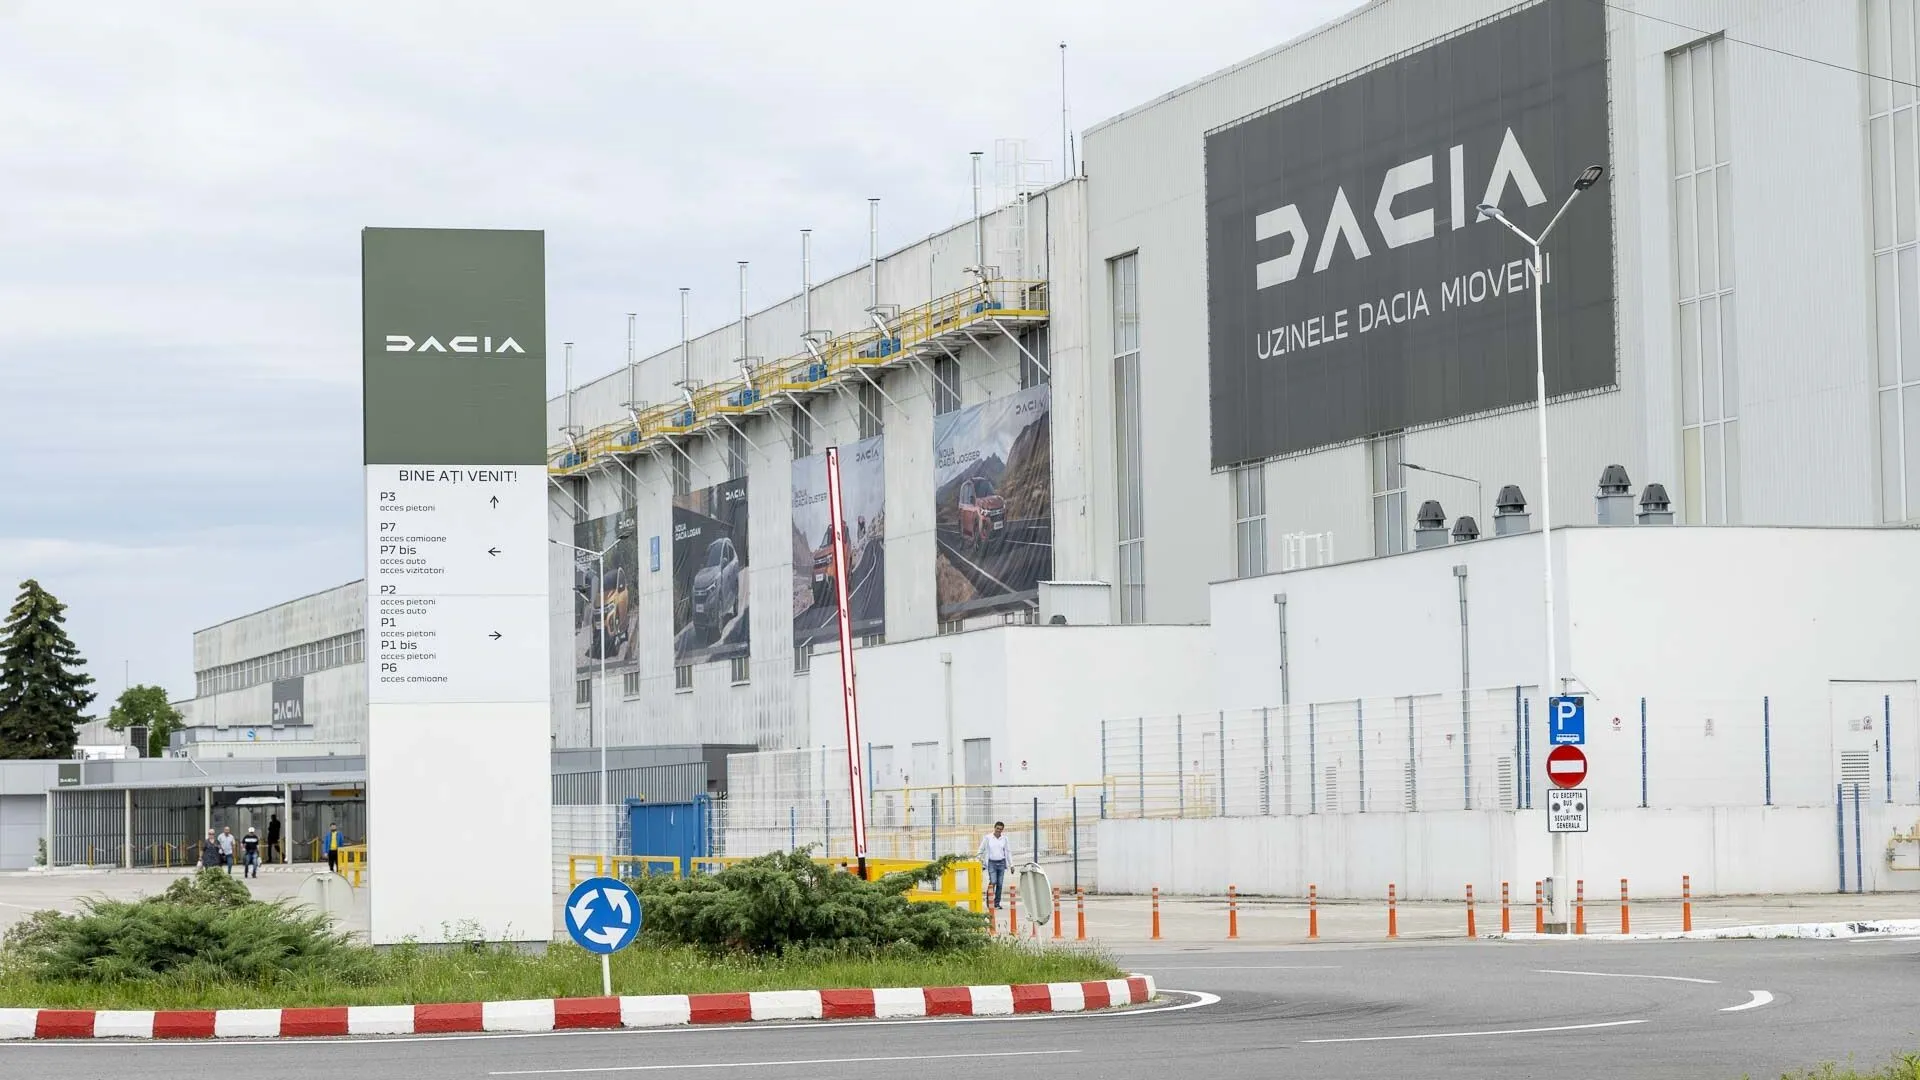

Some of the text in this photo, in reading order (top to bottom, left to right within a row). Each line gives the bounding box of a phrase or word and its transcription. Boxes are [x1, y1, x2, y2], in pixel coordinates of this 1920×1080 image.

[1256, 126, 1547, 290] DACIA
[1257, 252, 1550, 360] UZINELE DACIA MIOVENI
[386, 335, 526, 353] DACIA
[856, 448, 879, 462] DACIA
[938, 450, 980, 468] DACIA JOGGER
[399, 470, 517, 484] BINE AȚI VENIT!
[380, 491, 396, 501] P3
[725, 488, 745, 501] DACIA
[380, 504, 436, 513] acces pietoni
[380, 522, 396, 532] P7
[380, 545, 417, 555] P7 bis
[406, 557, 427, 565] auto
[406, 566, 445, 574] vizitatori
[380, 585, 396, 595] P2
[406, 598, 436, 606] pietoni
[406, 607, 427, 615] auto
[381, 617, 397, 627] P1
[406, 630, 436, 638] pietoni
[381, 640, 417, 650] P1 bis
[406, 652, 436, 661] pietoni
[381, 663, 397, 672] P6
[273, 699, 302, 719] DACIA
[1558, 702, 1577, 730] P
[1554, 814, 1582, 822] SECURITATE
